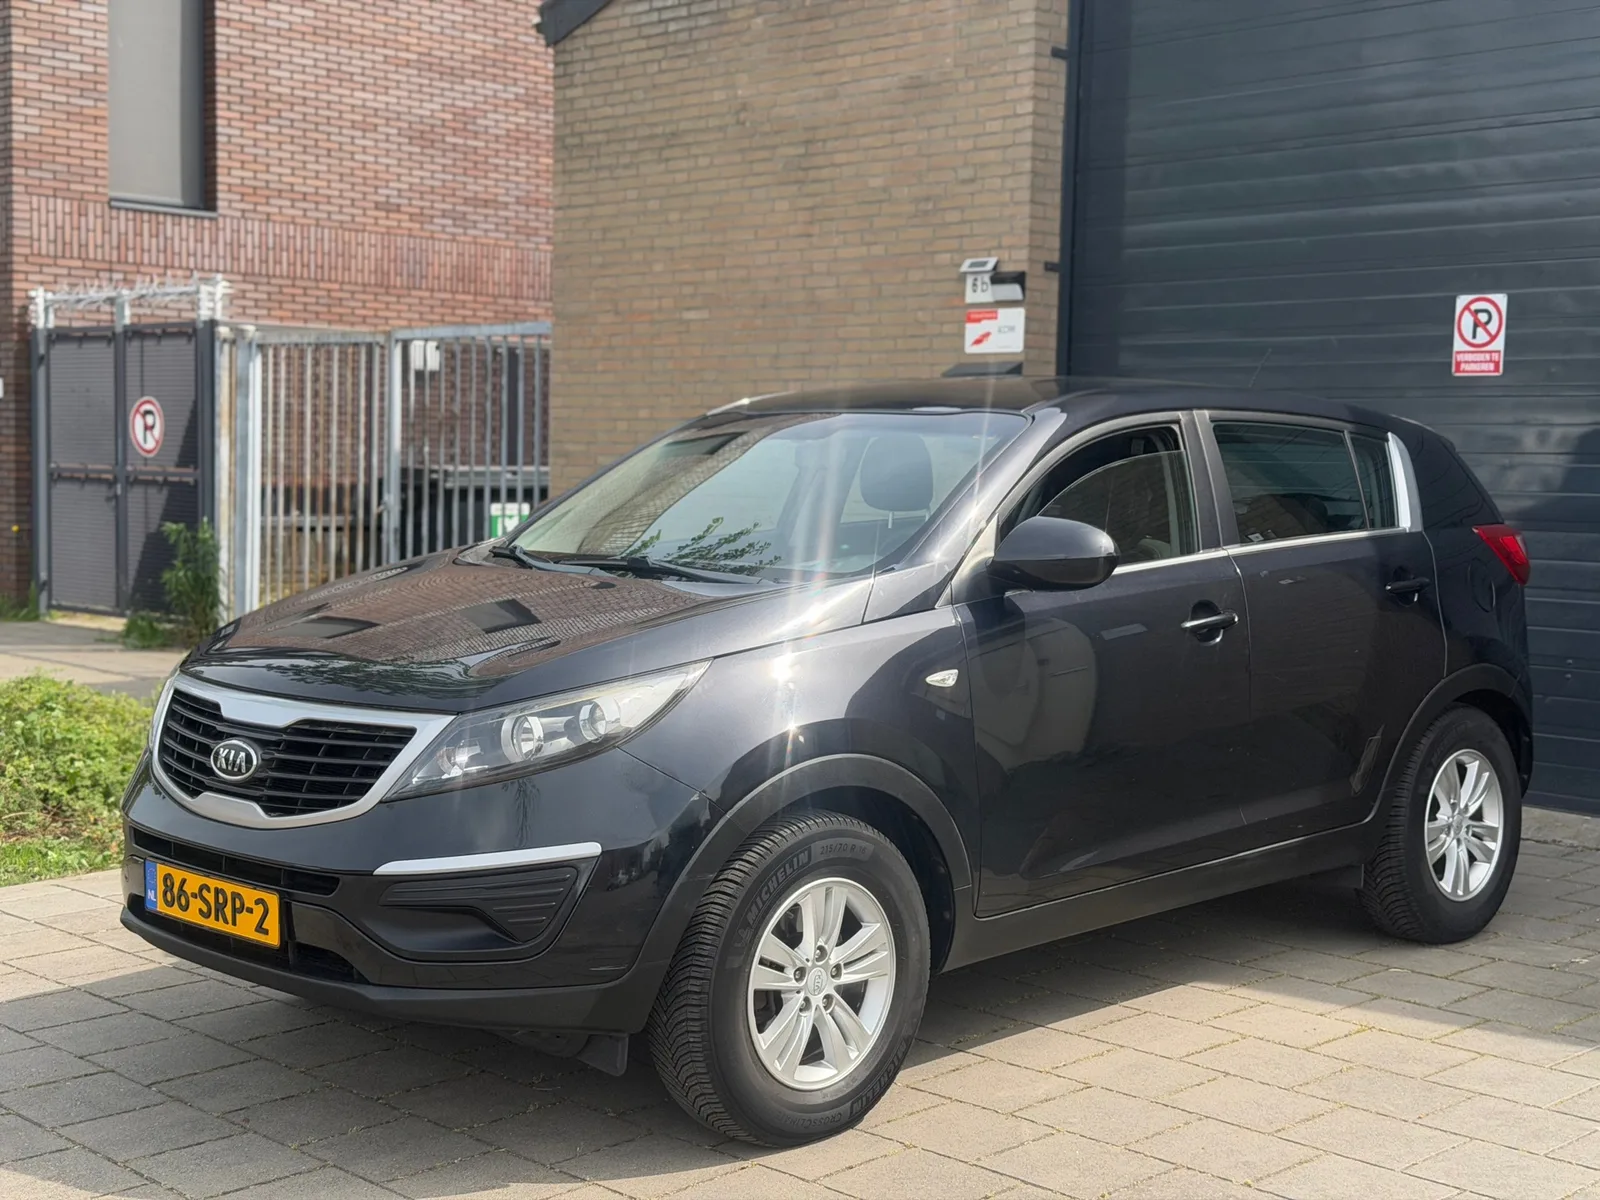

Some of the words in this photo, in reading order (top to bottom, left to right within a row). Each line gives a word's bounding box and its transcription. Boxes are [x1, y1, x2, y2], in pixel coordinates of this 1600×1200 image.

[217, 748, 246, 773] KIA
[819, 843, 848, 855] 215/70
[147, 889, 157, 902] NL
[746, 850, 810, 921] MICHELIN
[162, 873, 270, 936] 86-SRP-2
